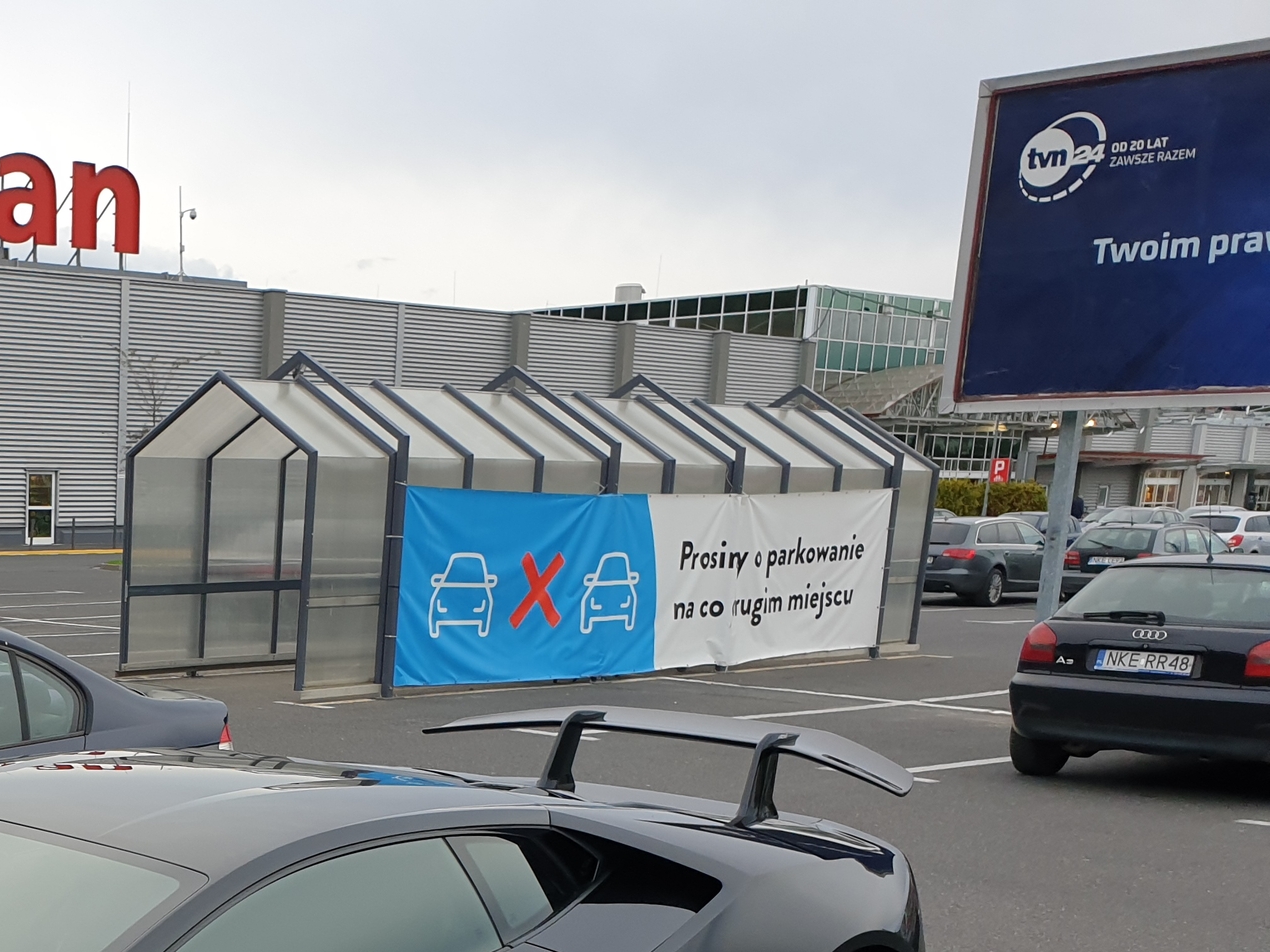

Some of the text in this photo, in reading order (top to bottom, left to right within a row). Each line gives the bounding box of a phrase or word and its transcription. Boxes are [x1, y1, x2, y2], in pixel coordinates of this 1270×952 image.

[1111, 137, 1169, 153] OD 20 LAT
[1109, 148, 1196, 167] ZAWSZE RAZEM
[1093, 231, 1270, 265] Twoim pra
[994, 460, 1005, 475] P
[754, 551, 762, 568] o
[766, 533, 865, 579] parkowanie
[673, 582, 854, 627] na co rugim miejscu
[1106, 651, 1190, 671] NKE RR48
